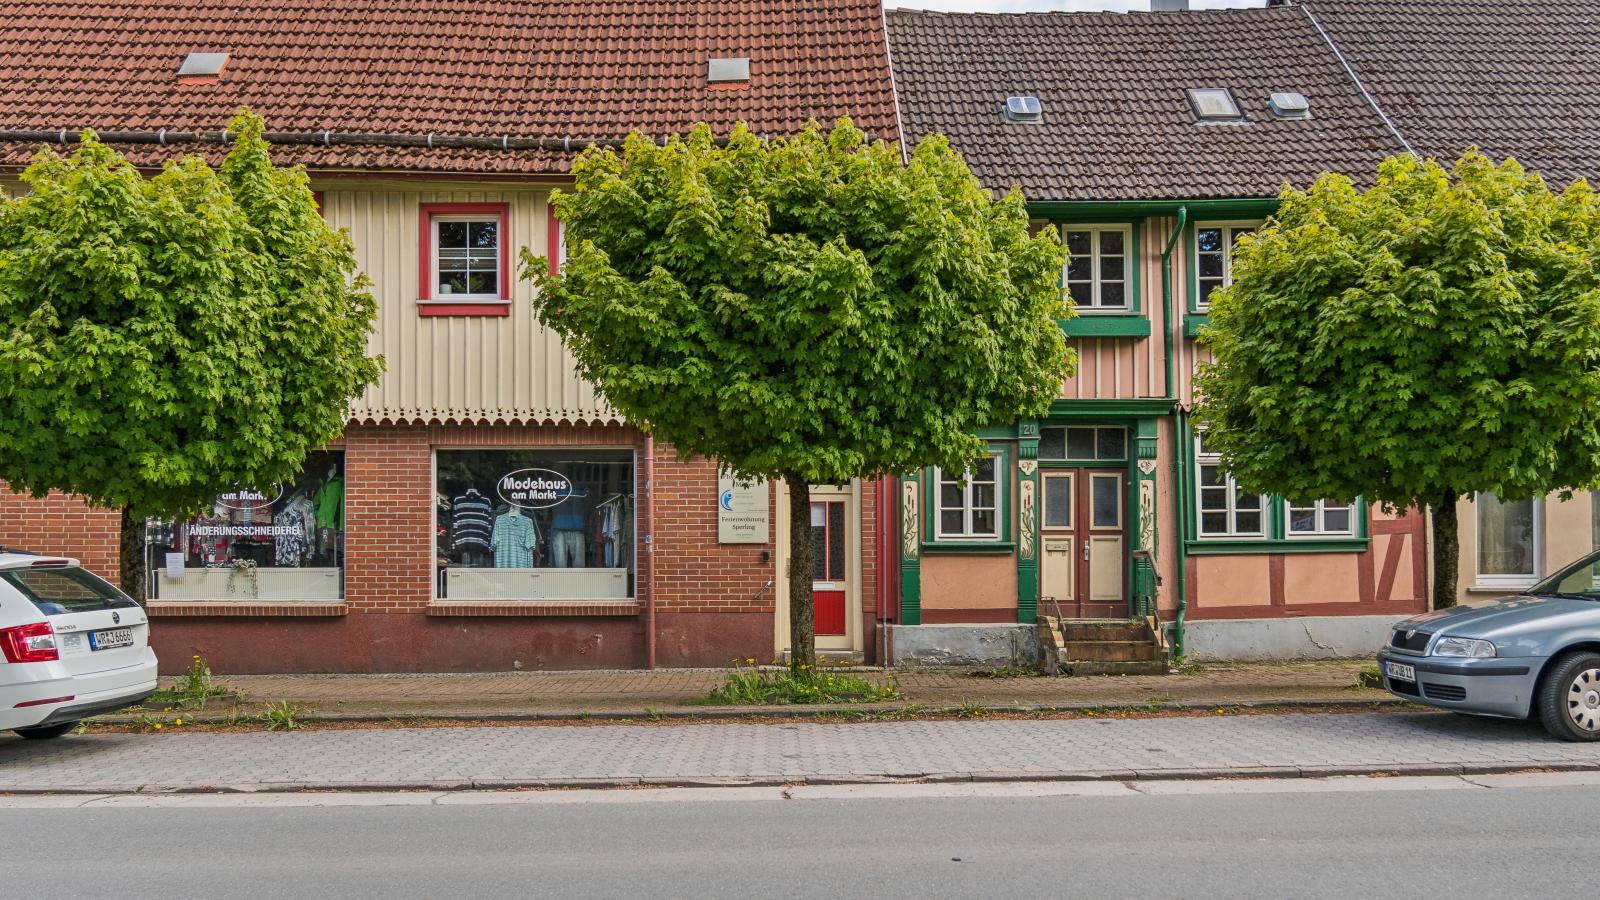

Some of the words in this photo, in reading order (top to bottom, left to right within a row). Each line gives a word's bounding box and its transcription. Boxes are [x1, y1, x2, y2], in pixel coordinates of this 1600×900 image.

[1023, 424, 1036, 435] 20
[503, 477, 567, 490] Modehaus
[240, 490, 268, 500] Mark
[511, 491, 527, 500] am
[529, 489, 557, 500] Markt
[189, 524, 301, 536] ÄNDERUNGSSCHNEIDEREI
[732, 523, 756, 531] Sperling
